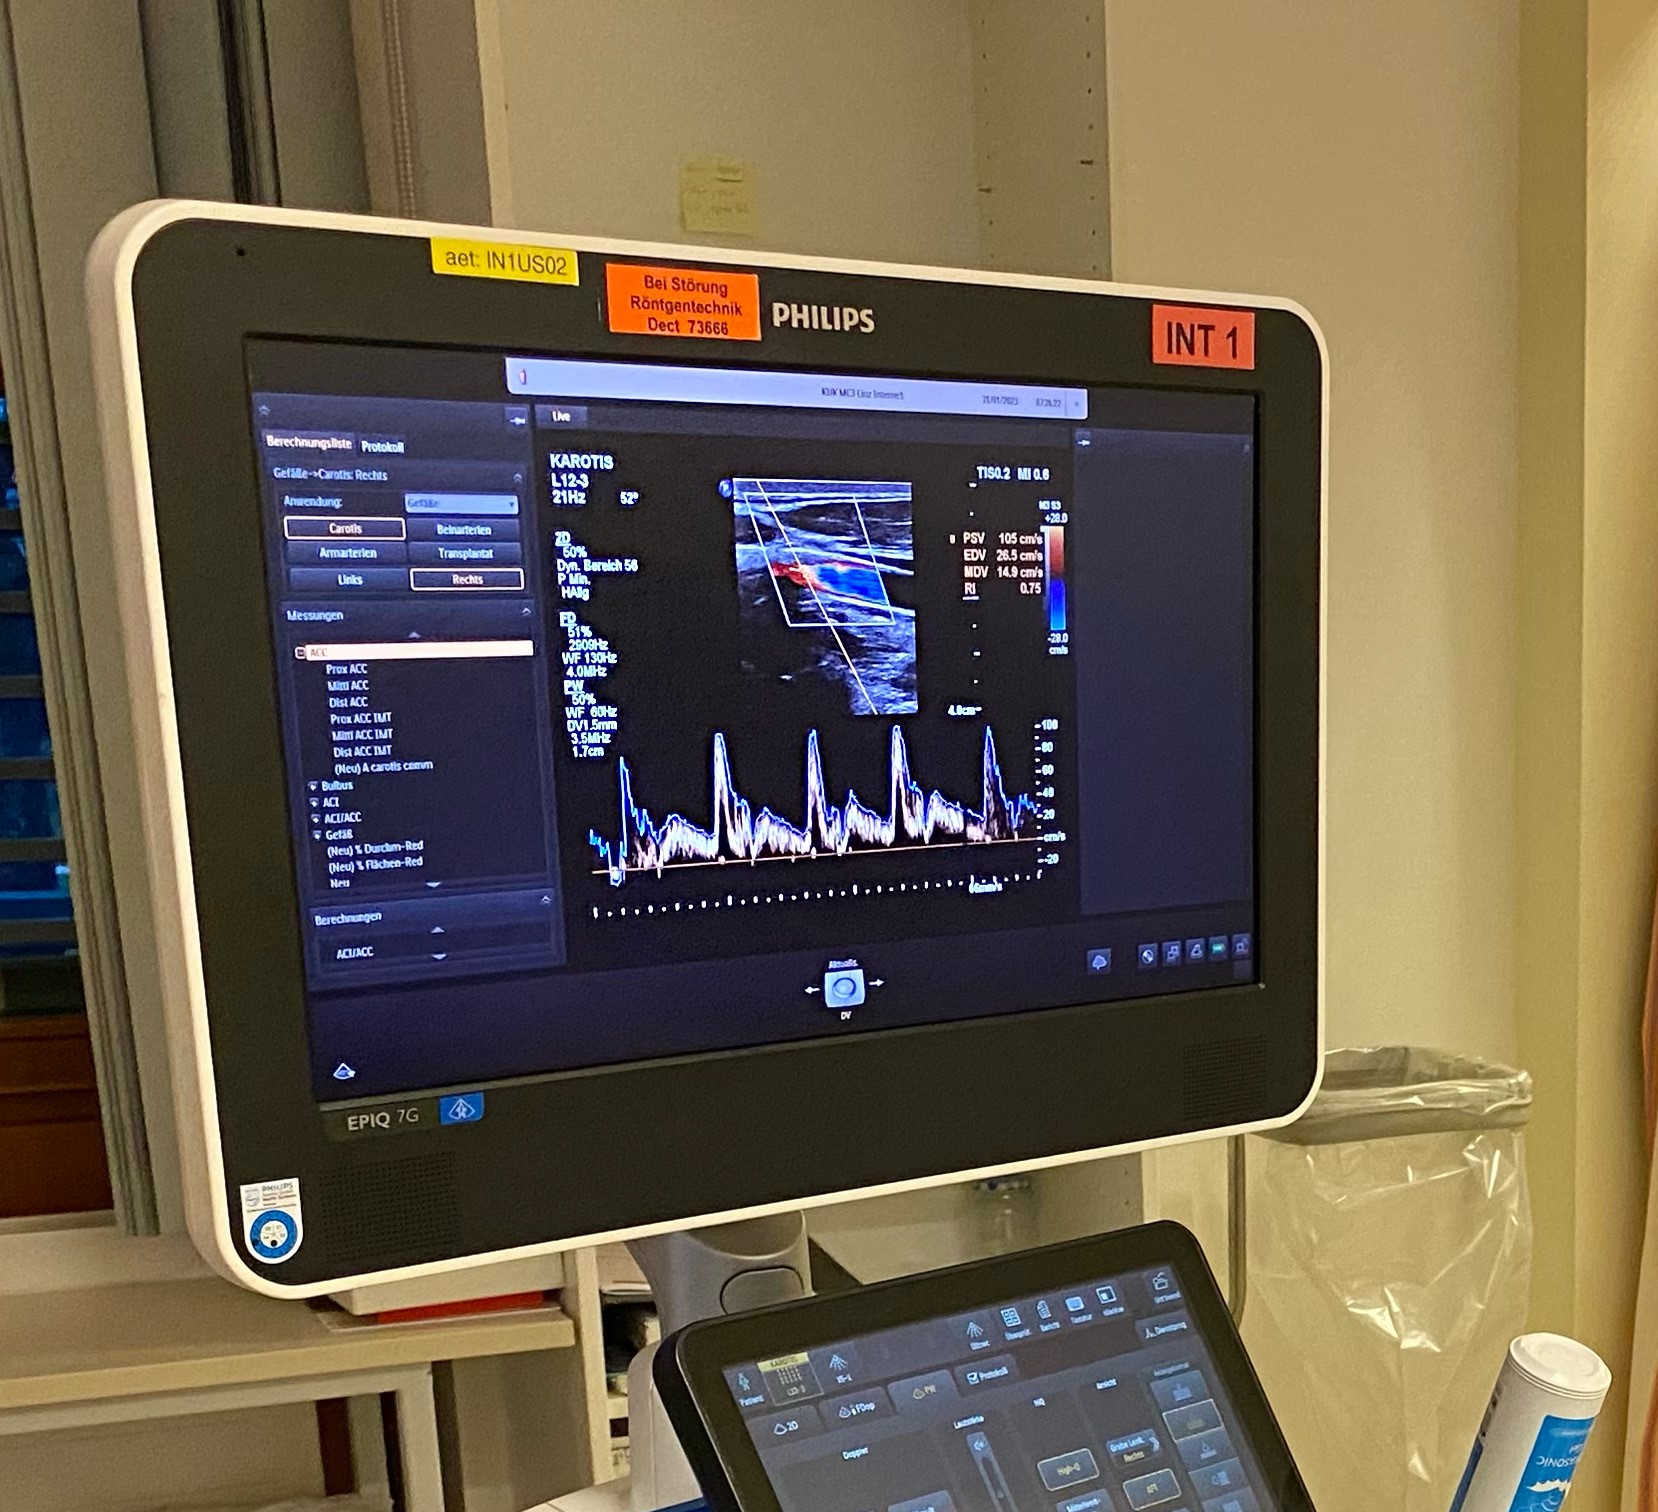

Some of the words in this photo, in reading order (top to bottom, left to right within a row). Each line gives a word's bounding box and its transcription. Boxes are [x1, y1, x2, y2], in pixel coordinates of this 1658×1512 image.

[445, 250, 480, 268] aet:
[486, 250, 567, 276] IN1US02
[644, 275, 667, 291] Bei
[671, 276, 728, 298] Störung
[630, 294, 743, 318] Röntgentechnik
[772, 302, 875, 333] PHILIPS
[648, 317, 680, 334] Dect
[688, 319, 728, 336] 73666
[1167, 321, 1215, 357] INT
[1226, 326, 1237, 359] 1
[552, 411, 571, 421] Live
[266, 435, 352, 450] Berechnungsliste
[361, 439, 405, 454] Protokoll
[550, 453, 614, 469] KAROTIS
[355, 470, 388, 481] Rechts
[551, 473, 589, 488] L12-3
[552, 490, 586, 504] 21Hz
[329, 522, 362, 535] Carotis
[437, 523, 492, 536] Beinarterien
[963, 532, 985, 544] PSV
[999, 533, 1017, 544] 105
[1019, 533, 1043, 545] cm/s
[319, 547, 377, 560] Armarterien
[439, 547, 493, 561] Transplantat
[964, 549, 986, 561] EDV
[1019, 550, 1043, 561] cm/s
[964, 566, 988, 578] MDV
[997, 566, 1018, 578] 14.9
[1020, 566, 1043, 577] cm/s
[338, 573, 363, 586] Links
[452, 573, 483, 585] Rechts
[964, 583, 976, 594] RI
[1020, 583, 1041, 594] 0.75
[287, 609, 344, 623] Messungen
[326, 664, 348, 675] Prox
[350, 663, 368, 674] ACC
[351, 680, 369, 691] ACC
[329, 697, 348, 708] Dist
[350, 696, 368, 707] ACC
[330, 714, 352, 725] Prox
[354, 713, 372, 724] ACC
[355, 729, 373, 741] ACC
[334, 747, 352, 758] Dist
[354, 746, 372, 757] ACC
[321, 780, 353, 792] Bulbus
[315, 911, 381, 926] Berechnungen
[348, 1112, 390, 1131] EPIQ
[397, 1108, 419, 1123] 7G
